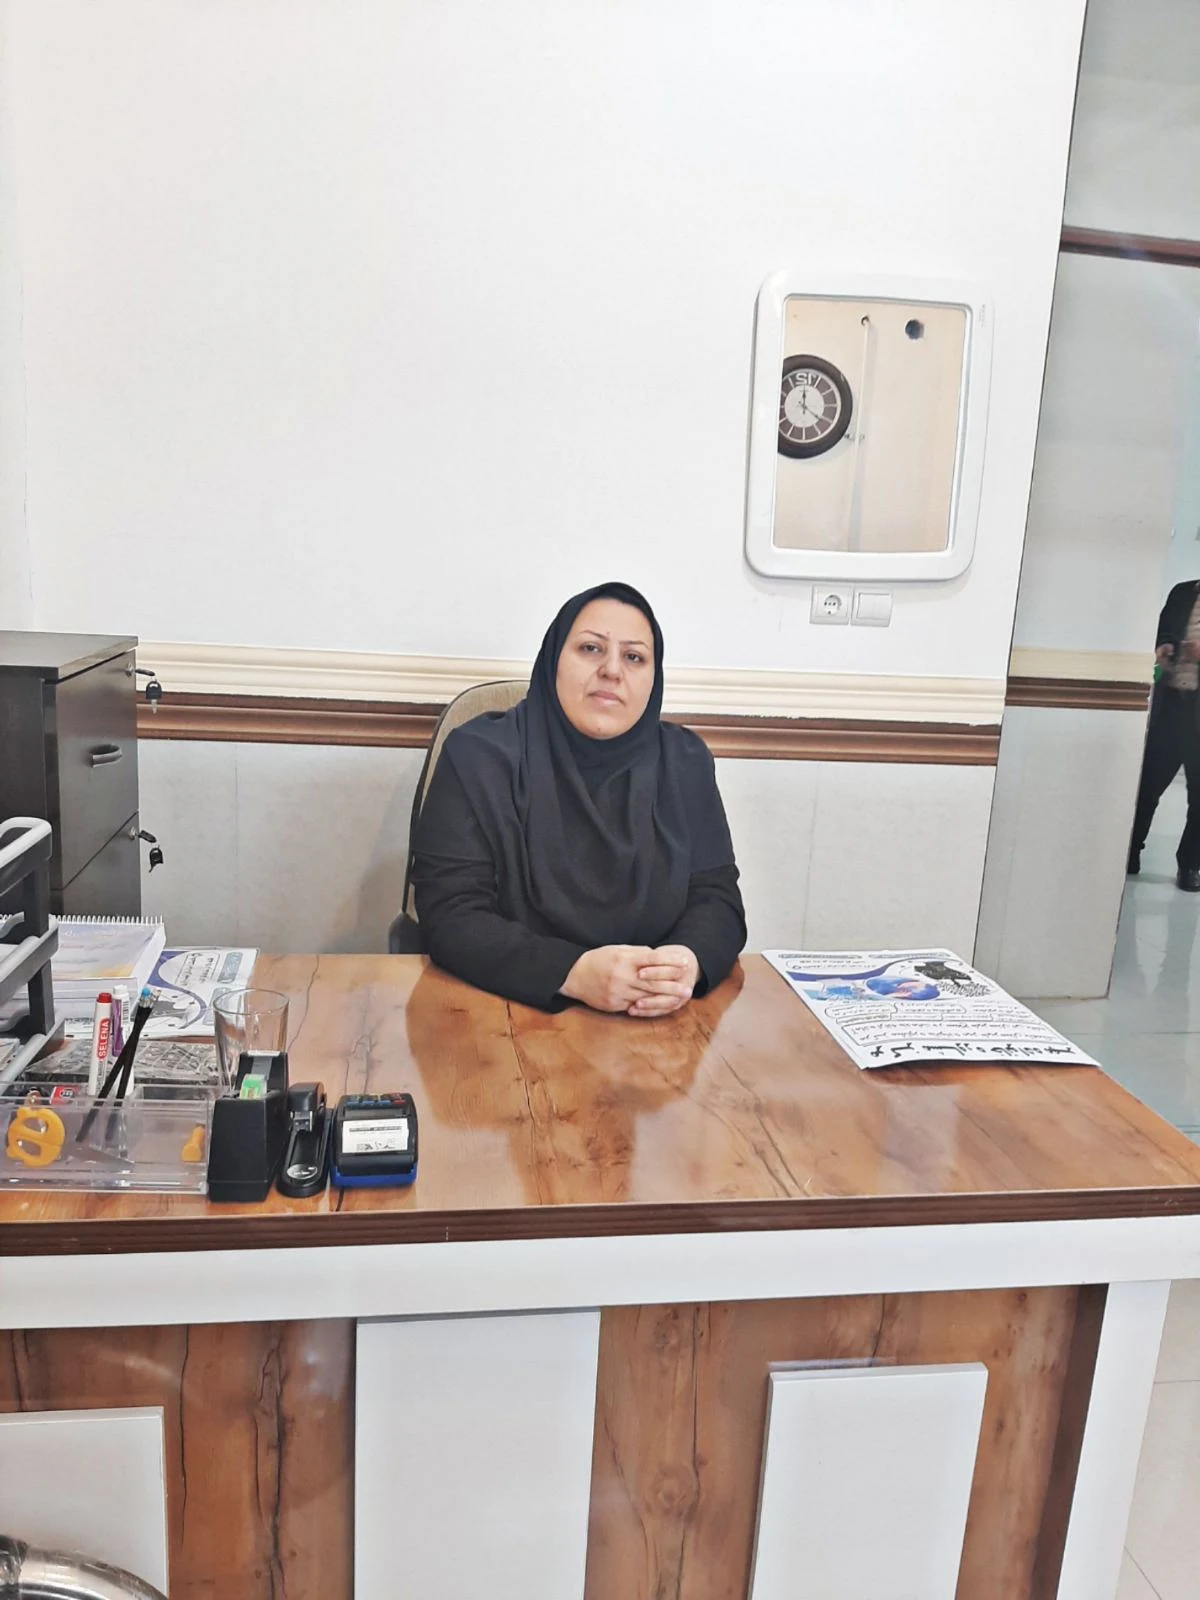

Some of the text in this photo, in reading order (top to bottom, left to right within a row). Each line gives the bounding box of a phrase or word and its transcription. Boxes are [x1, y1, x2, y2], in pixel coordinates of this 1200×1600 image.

[98, 1019, 110, 1058] SELENA
[870, 1042, 920, 1059] مرکز
[922, 1043, 986, 1057] مشاوره
[990, 1043, 1043, 1057] خانواده
